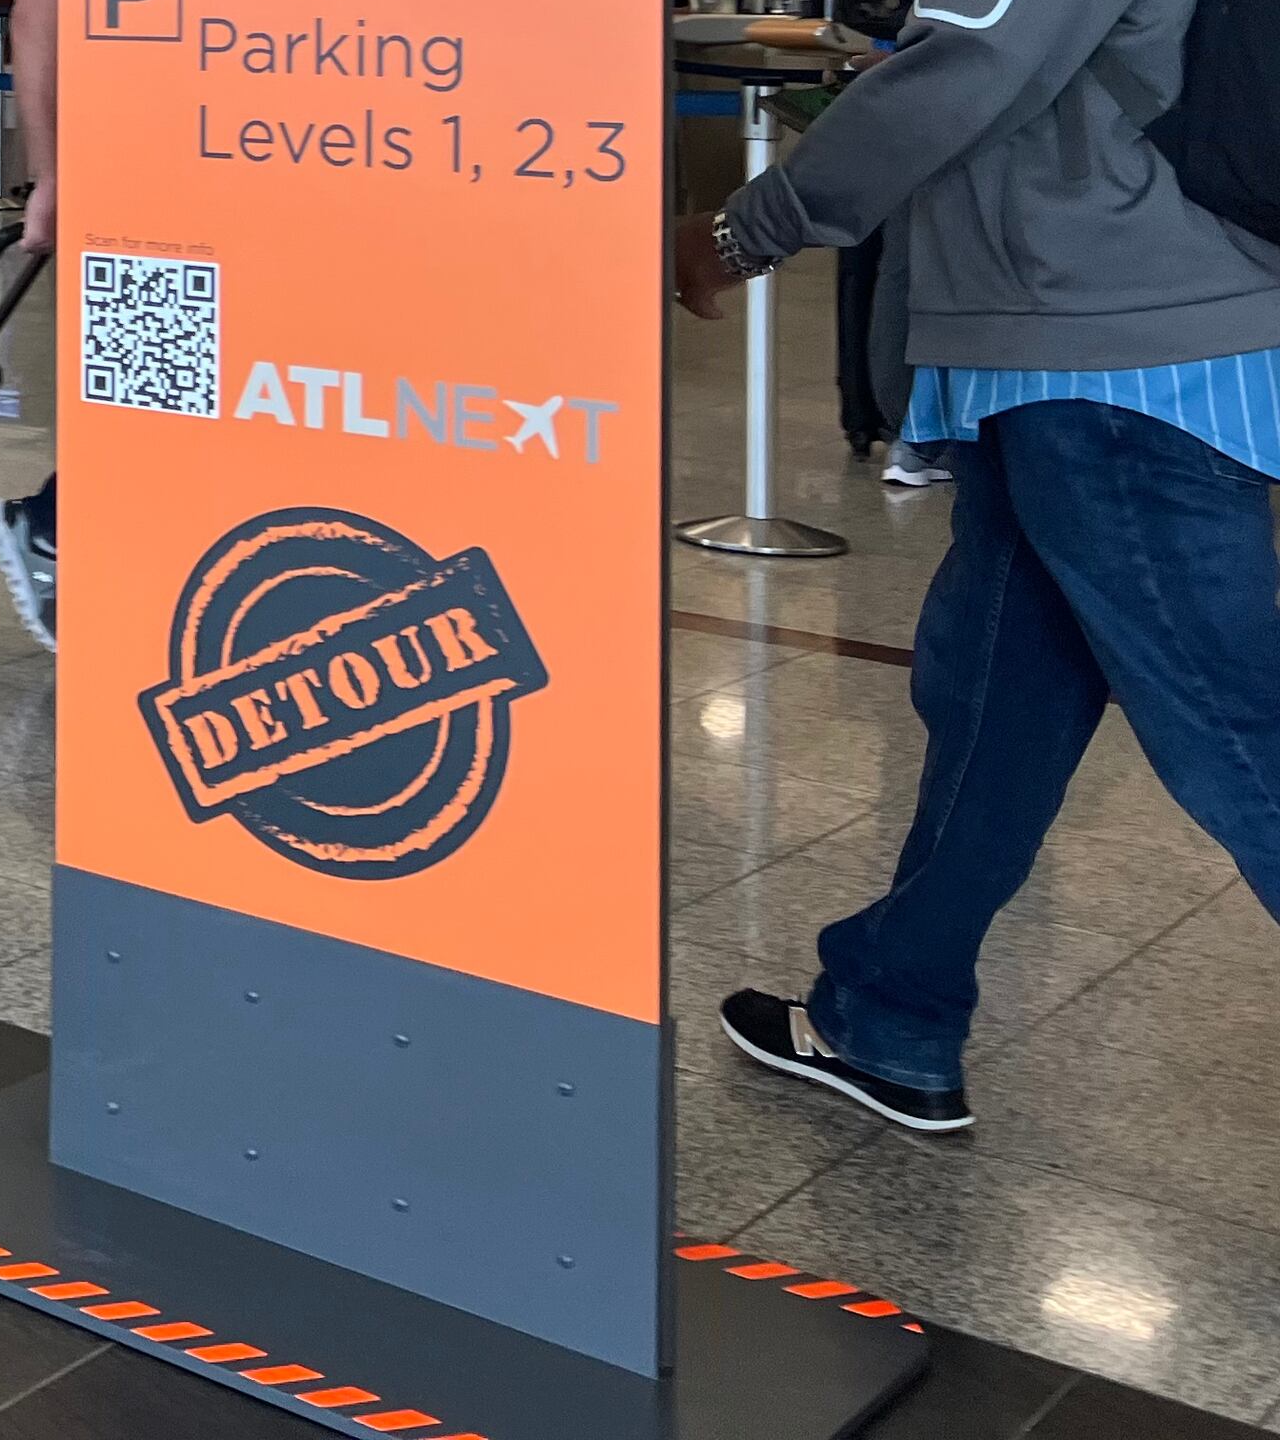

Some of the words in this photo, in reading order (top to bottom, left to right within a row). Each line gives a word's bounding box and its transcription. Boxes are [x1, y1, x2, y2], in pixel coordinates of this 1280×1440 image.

[200, 17, 464, 93] Parking
[200, 105, 414, 171] Levels
[442, 115, 483, 183] 1,
[514, 118, 627, 188] 2,3
[85, 233, 117, 247] Scan
[122, 236, 143, 249] for
[145, 241, 182, 253] more
[184, 606, 500, 770] DETOUR
